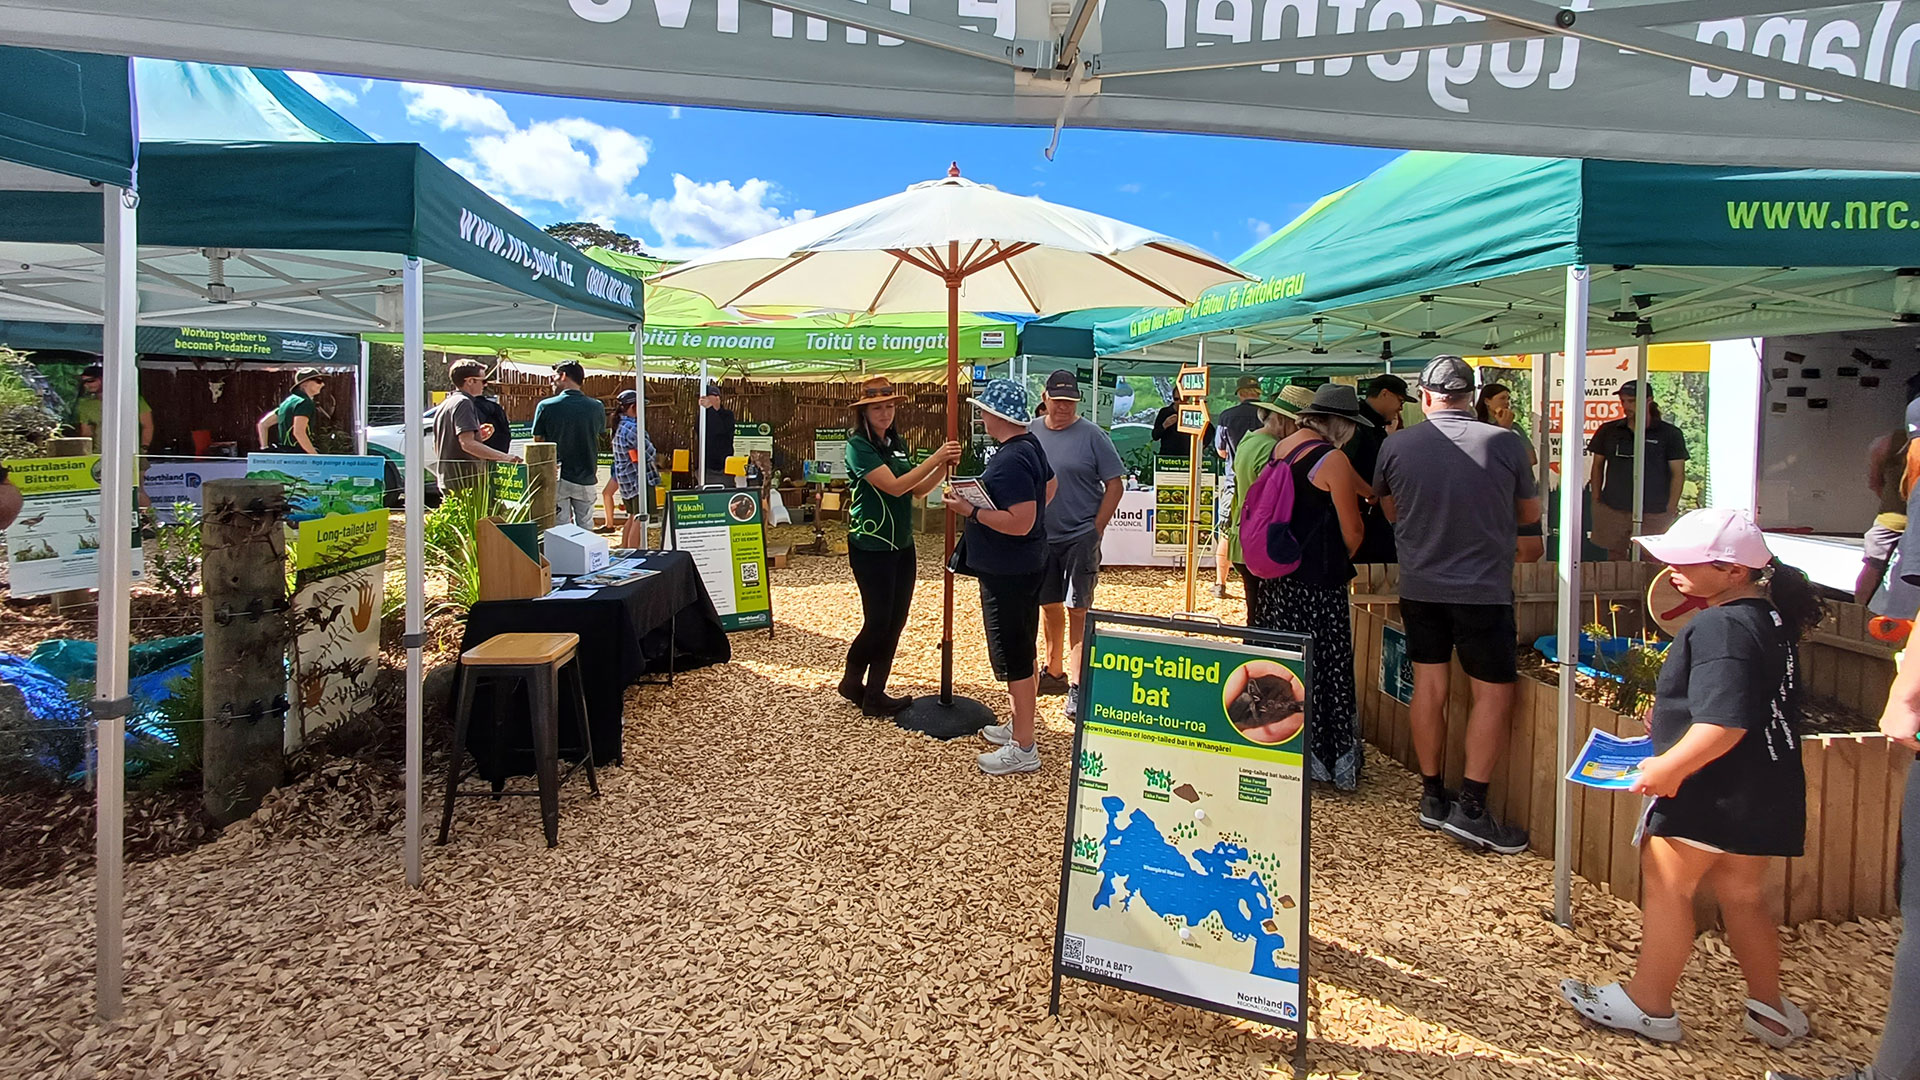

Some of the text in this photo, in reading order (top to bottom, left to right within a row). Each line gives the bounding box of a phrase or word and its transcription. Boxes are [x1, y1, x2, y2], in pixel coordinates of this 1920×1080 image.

[1727, 201, 1920, 229] www.nrc.
[459, 206, 575, 288] www.nrc.govt.nz
[1226, 287, 1239, 311] Te
[181, 327, 267, 343] Working together to
[682, 332, 702, 347] te
[706, 334, 775, 350] moana
[806, 332, 853, 350] Toitū
[858, 333, 876, 350] te
[175, 339, 213, 351] become
[214, 341, 252, 354] Predator
[253, 344, 271, 354] Free
[1586, 403, 1619, 418] COS
[7, 461, 86, 473] Australasian
[24, 475, 69, 484] Bittern
[144, 474, 184, 482] Northland
[317, 521, 378, 542] Long-tailed bat
[1089, 646, 1220, 684] Long-tailed
[1132, 682, 1170, 708] bat
[1094, 703, 1206, 733] Pekapeka-tou-roa
[1104, 726, 1132, 738] locations
[1141, 732, 1176, 744] long-tailed
[1177, 738, 1188, 746] bat
[1085, 955, 1104, 966] SPOT
[1106, 961, 1112, 969] A
[1113, 962, 1133, 973] BAT?
[1237, 992, 1283, 1009] Northland
